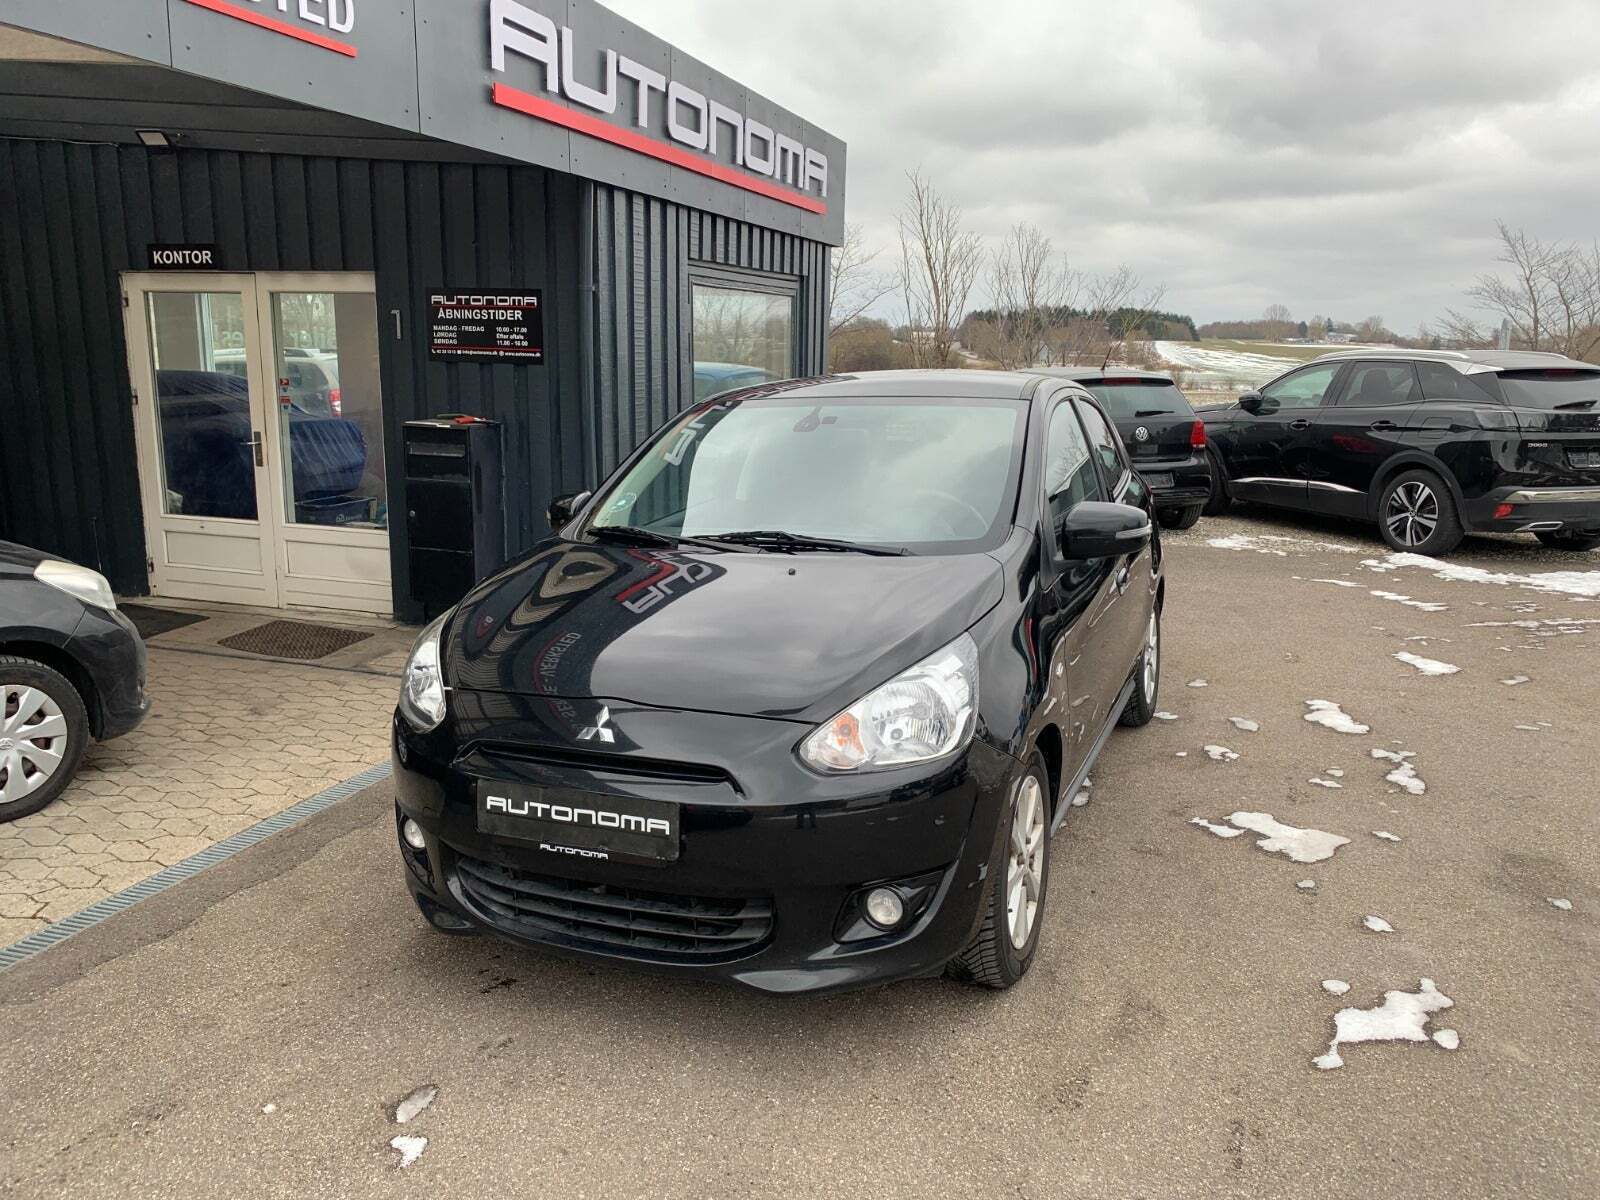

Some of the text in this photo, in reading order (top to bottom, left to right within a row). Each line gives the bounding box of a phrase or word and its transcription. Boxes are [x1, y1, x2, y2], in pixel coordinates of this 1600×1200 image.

[489, 0, 827, 197] AUTONOMA
[153, 250, 212, 264] KONTOR
[431, 295, 537, 306] AUTONOMA
[437, 307, 523, 320] ÅBNINGSTIDER
[486, 795, 670, 836] AUTONOMA
[539, 843, 609, 860] AUTONOMA
